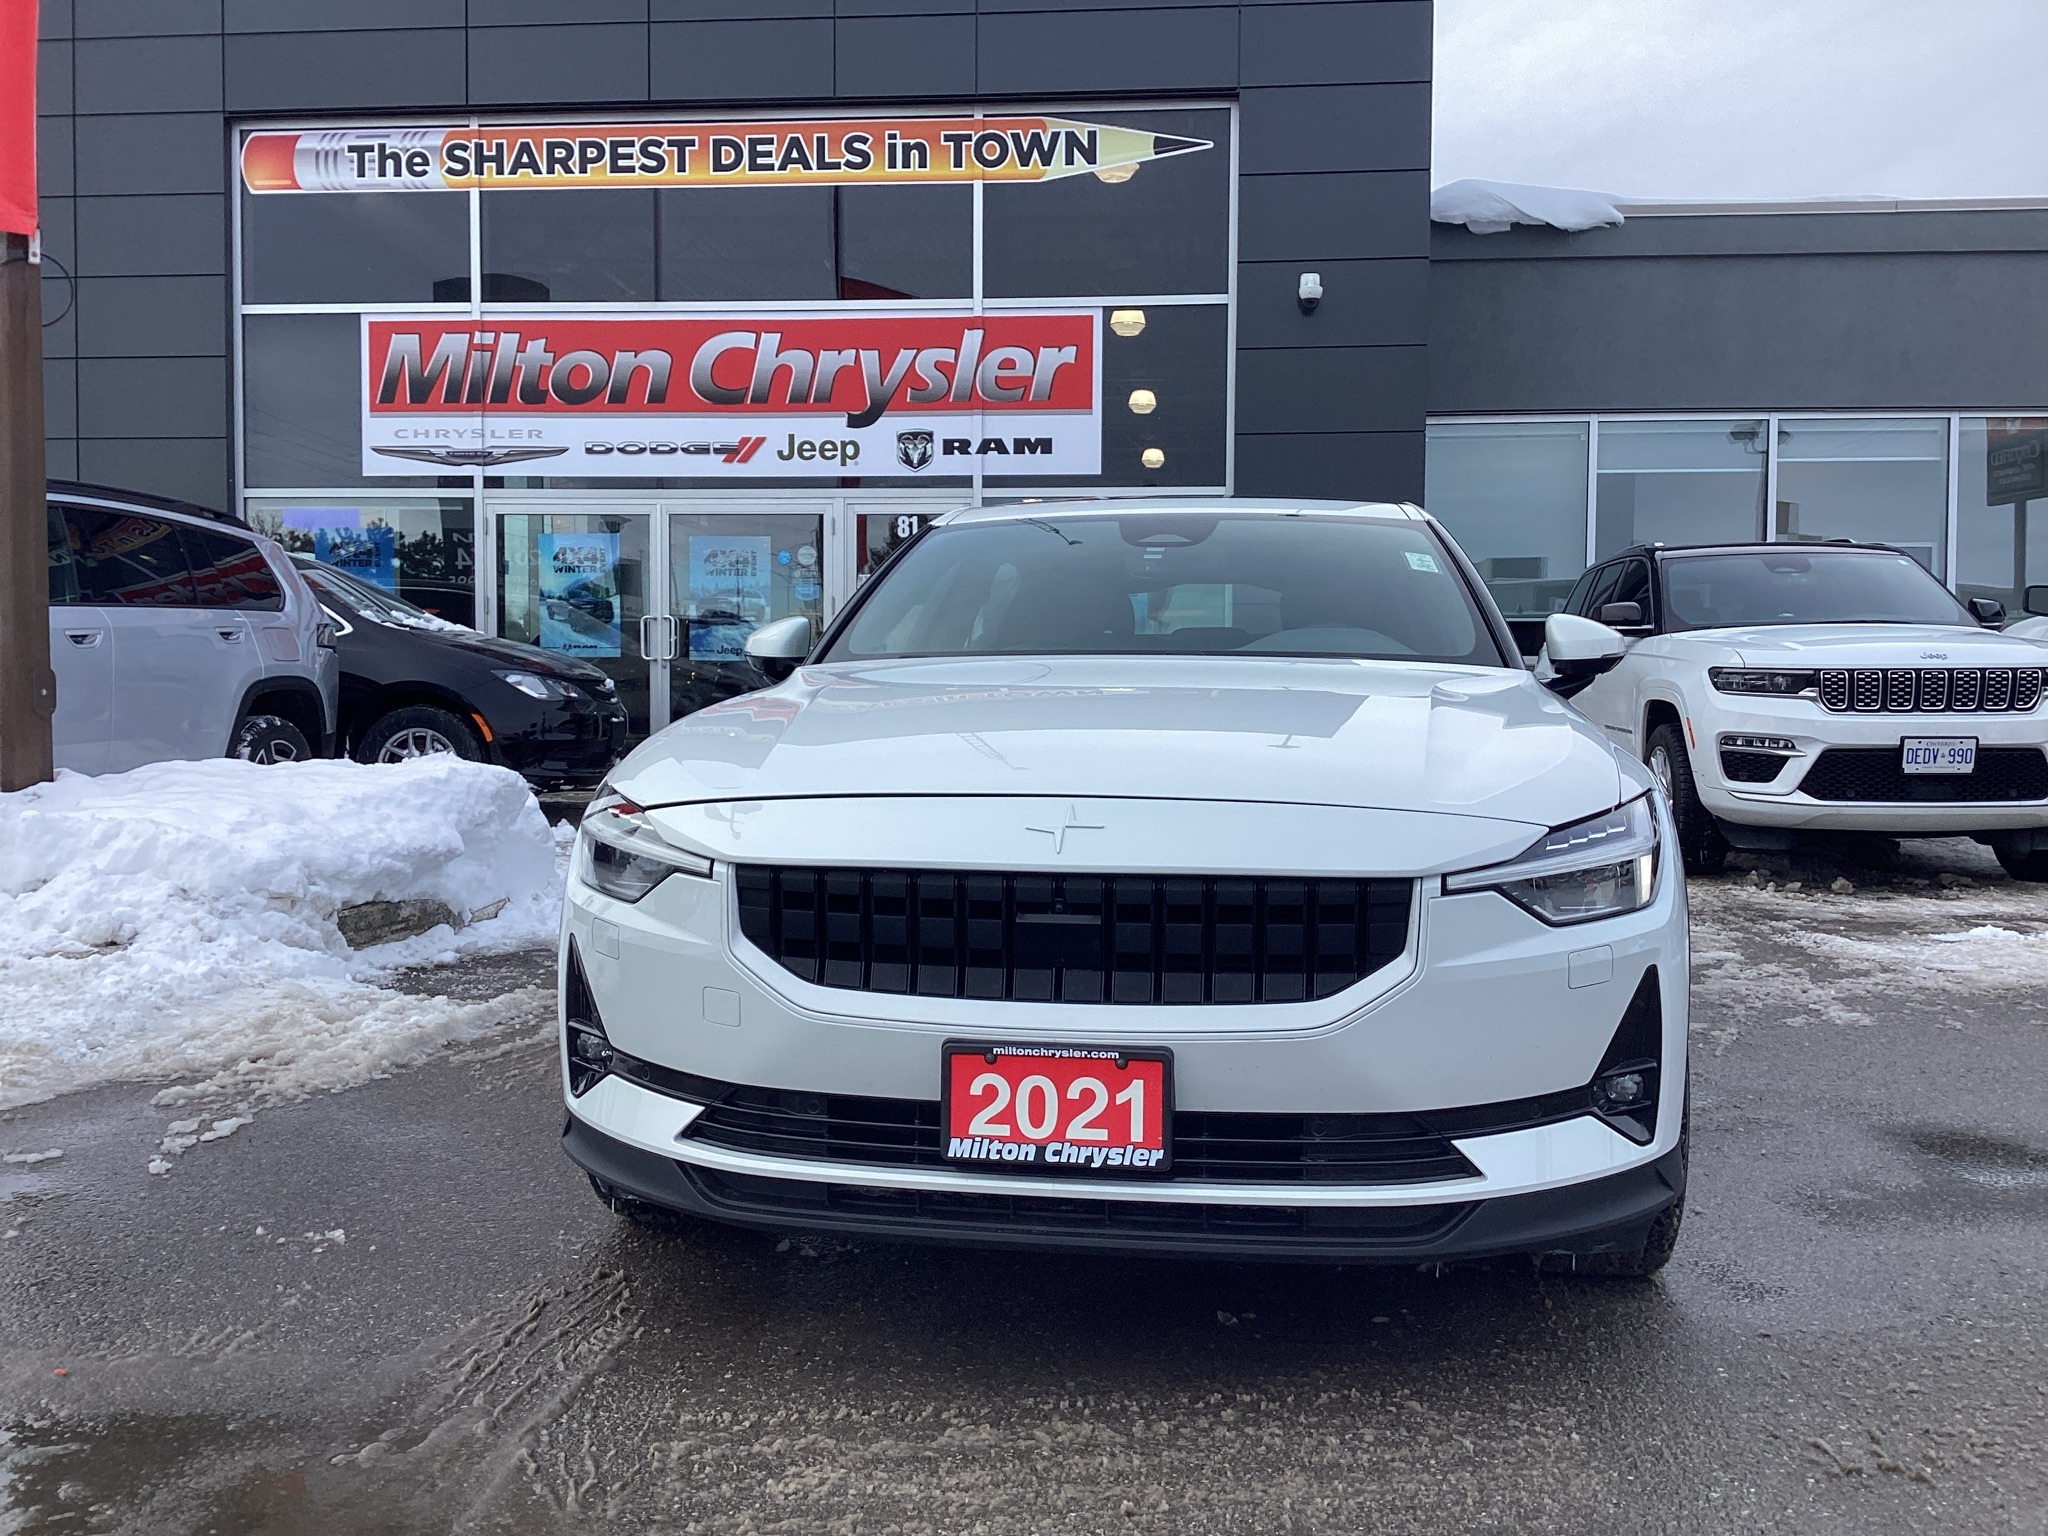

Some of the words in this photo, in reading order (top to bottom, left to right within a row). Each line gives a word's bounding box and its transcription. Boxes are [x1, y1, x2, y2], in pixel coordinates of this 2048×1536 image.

[347, 144, 431, 179] The
[444, 138, 695, 176] SHARPEST
[711, 134, 872, 172] DEALS
[887, 132, 929, 169] in
[943, 129, 1098, 169] TOWN
[376, 331, 674, 405] Milton
[690, 328, 1077, 428] Chrysler
[393, 428, 544, 439] CHRYSLER
[584, 440, 741, 455] DODGE
[776, 433, 861, 467] Jeep
[942, 437, 1053, 456] RAM
[552, 546, 599, 565] 4X4
[703, 549, 751, 568] 4X4
[552, 565, 598, 574] WINTER
[704, 568, 749, 577] WINTER
[716, 645, 743, 657] Jeep
[1906, 747, 1940, 765] DEDV
[1947, 747, 1973, 764] 990
[992, 1046, 1120, 1059] miltonchrysler.com
[967, 1072, 1144, 1143] 2021
[947, 1137, 1037, 1161] Milton
[1044, 1141, 1165, 1168] Chrysler
